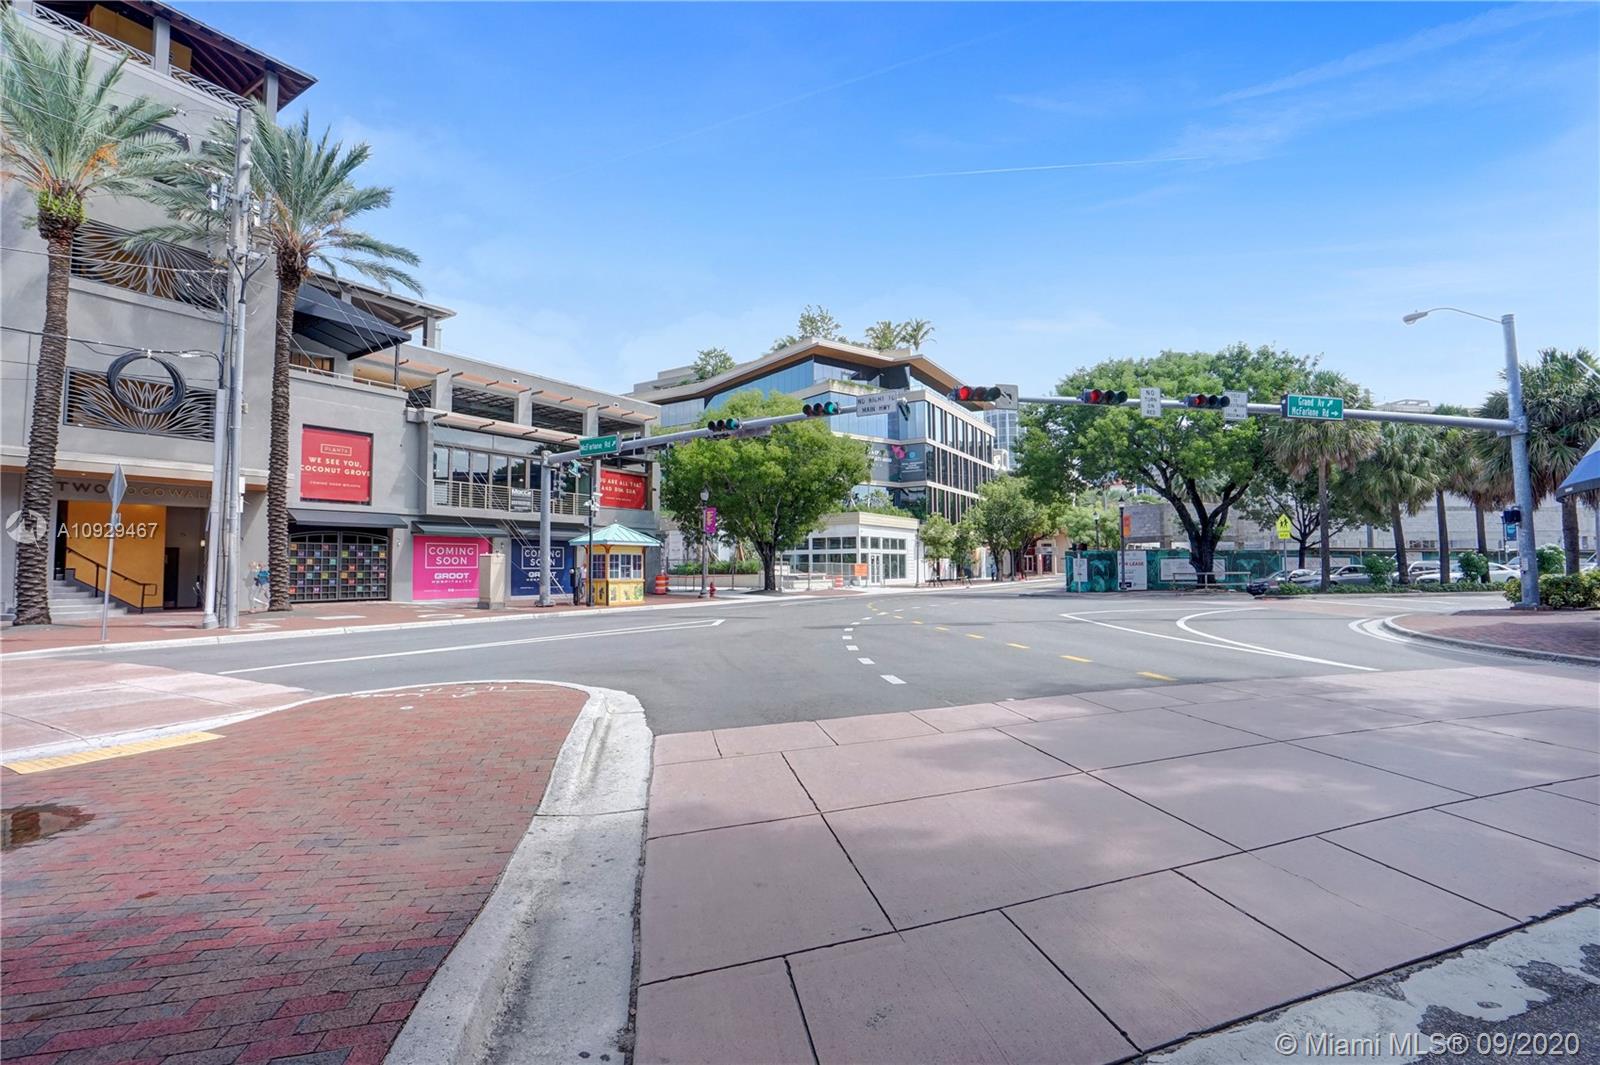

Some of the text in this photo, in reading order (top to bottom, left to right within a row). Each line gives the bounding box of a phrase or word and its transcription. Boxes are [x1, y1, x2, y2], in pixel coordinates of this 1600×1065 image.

[1297, 397, 1314, 407] Grand
[1291, 407, 1329, 417] McFarlane Rd
[300, 465, 341, 474] COCONUT
[55, 481, 107, 494] TWO
[428, 547, 474, 556] COMING
[435, 556, 468, 565] SOON
[434, 572, 470, 580] GROOT
